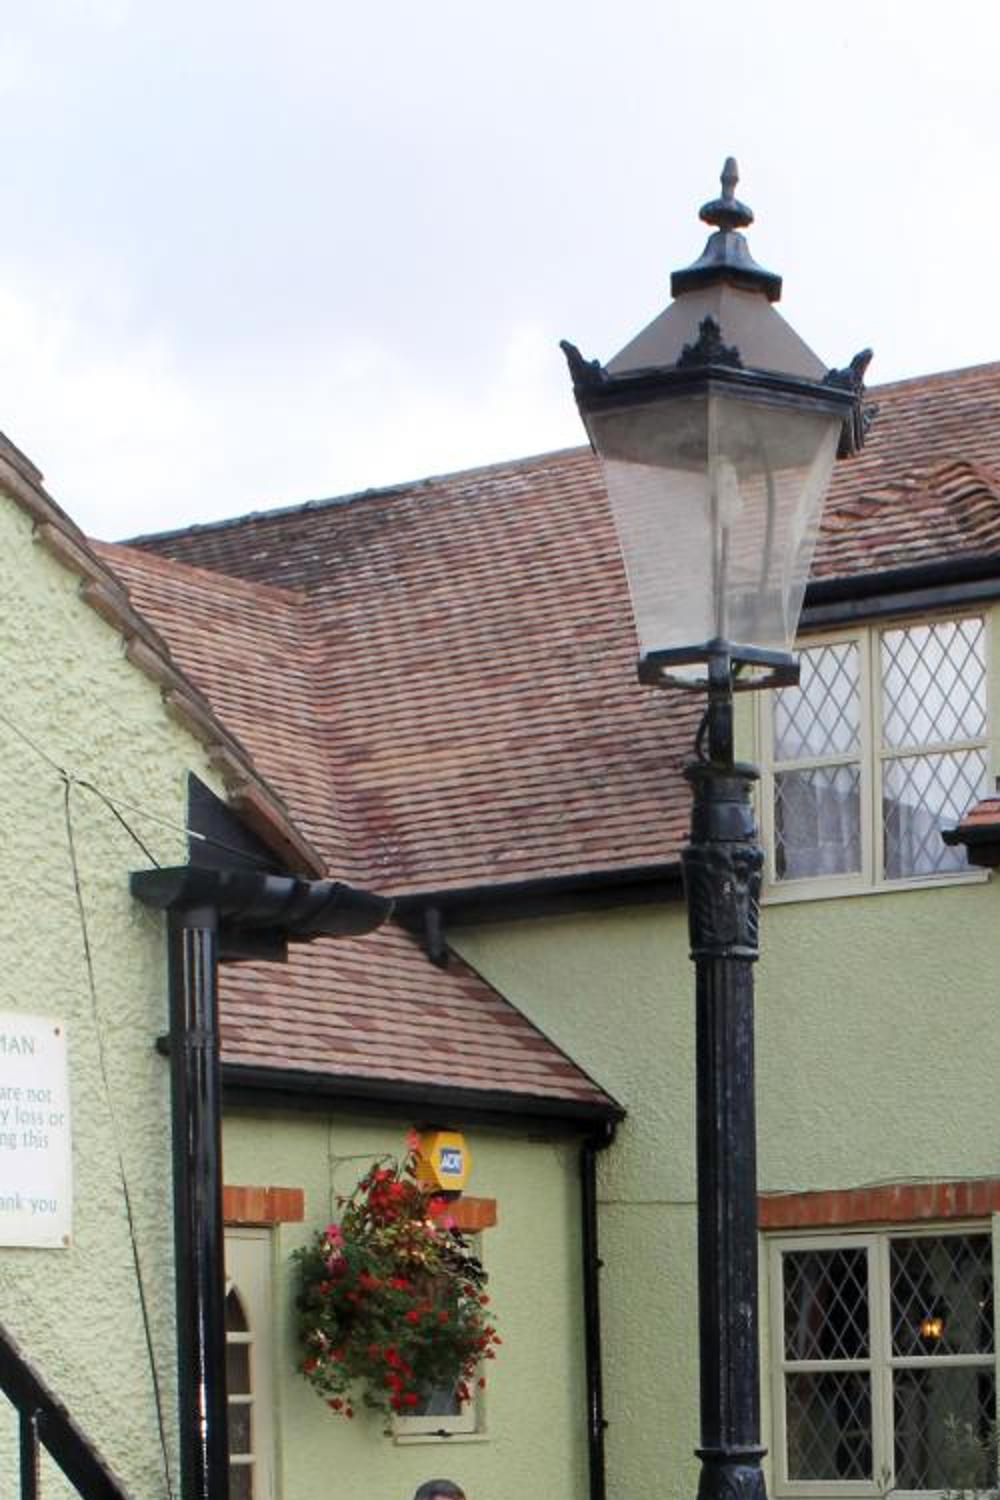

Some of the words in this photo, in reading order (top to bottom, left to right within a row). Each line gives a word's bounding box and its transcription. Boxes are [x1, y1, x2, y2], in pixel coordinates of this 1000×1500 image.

[27, 1088, 52, 1104] not
[16, 1106, 44, 1126] loss
[49, 1111, 65, 1127] or
[23, 1128, 49, 1150] this
[31, 1198, 58, 1217] you
